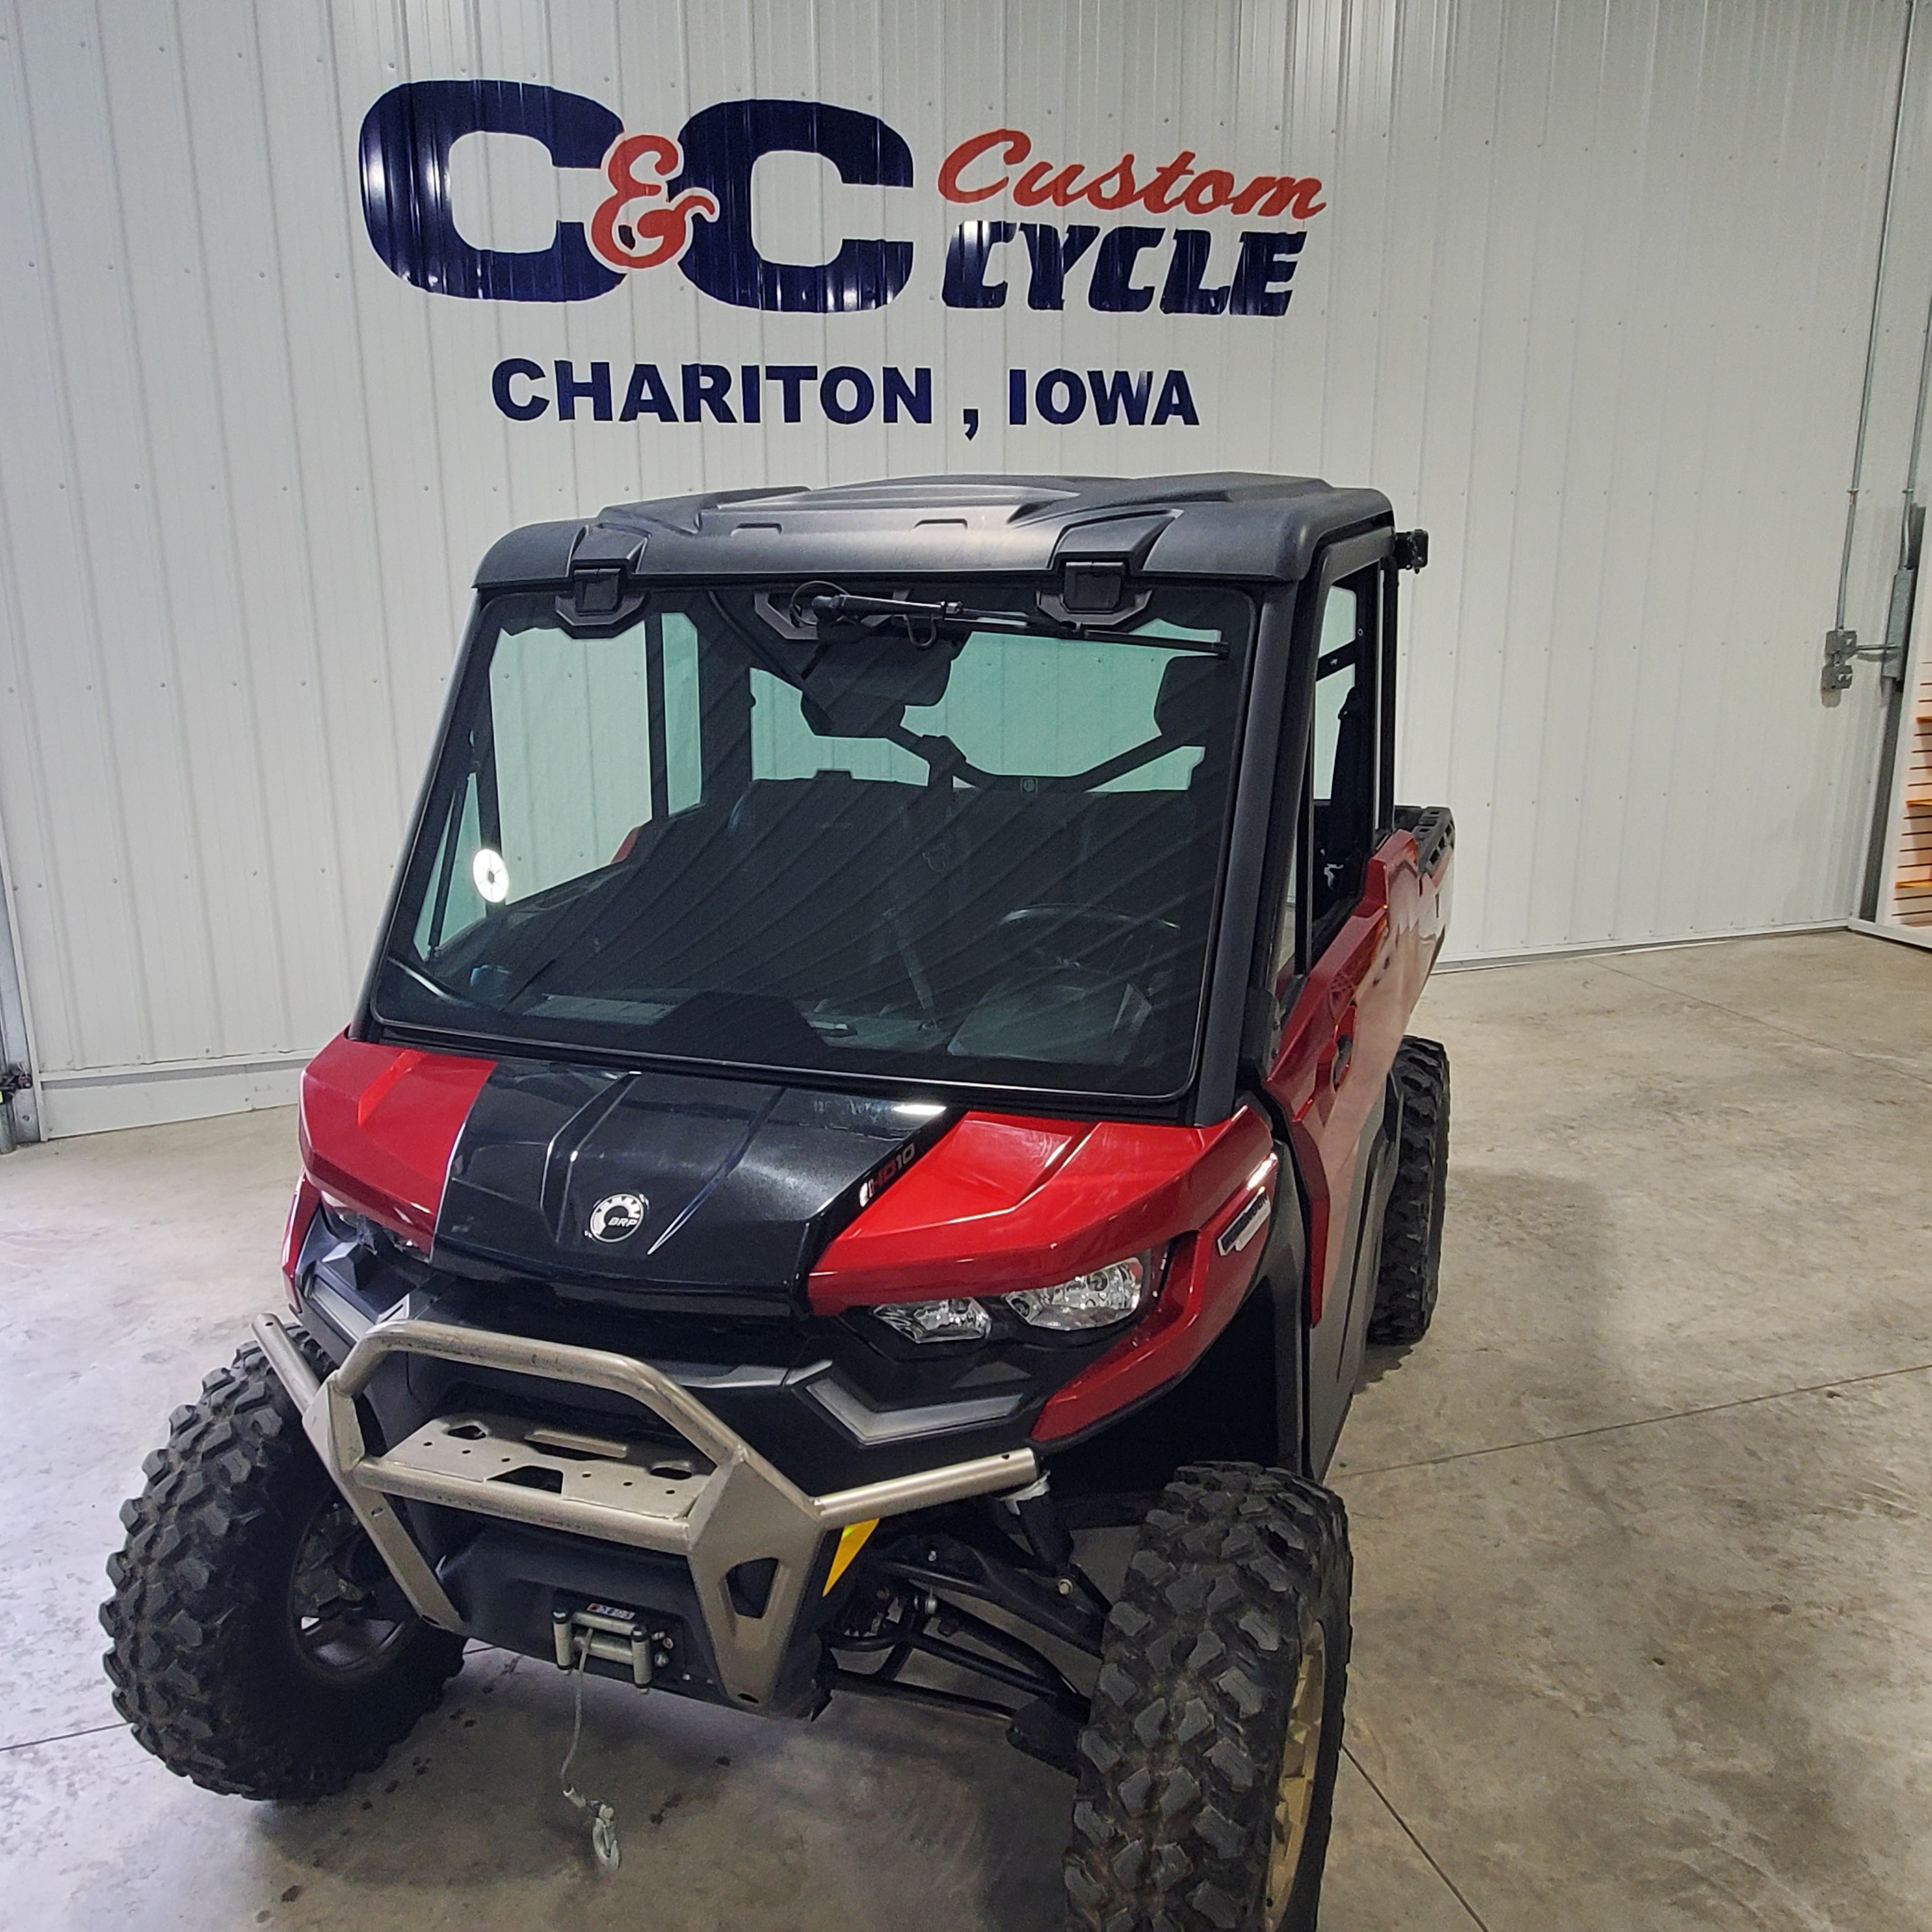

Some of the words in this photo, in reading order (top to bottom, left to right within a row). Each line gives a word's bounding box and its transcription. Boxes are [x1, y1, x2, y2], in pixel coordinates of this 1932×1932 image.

[359, 80, 914, 314] C&C
[938, 129, 1327, 219] Custom
[942, 220, 1308, 317] CYCLE
[492, 358, 932, 425] CHARITON
[1009, 368, 1200, 426] IOWA
[608, 1216, 638, 1227] BRP
